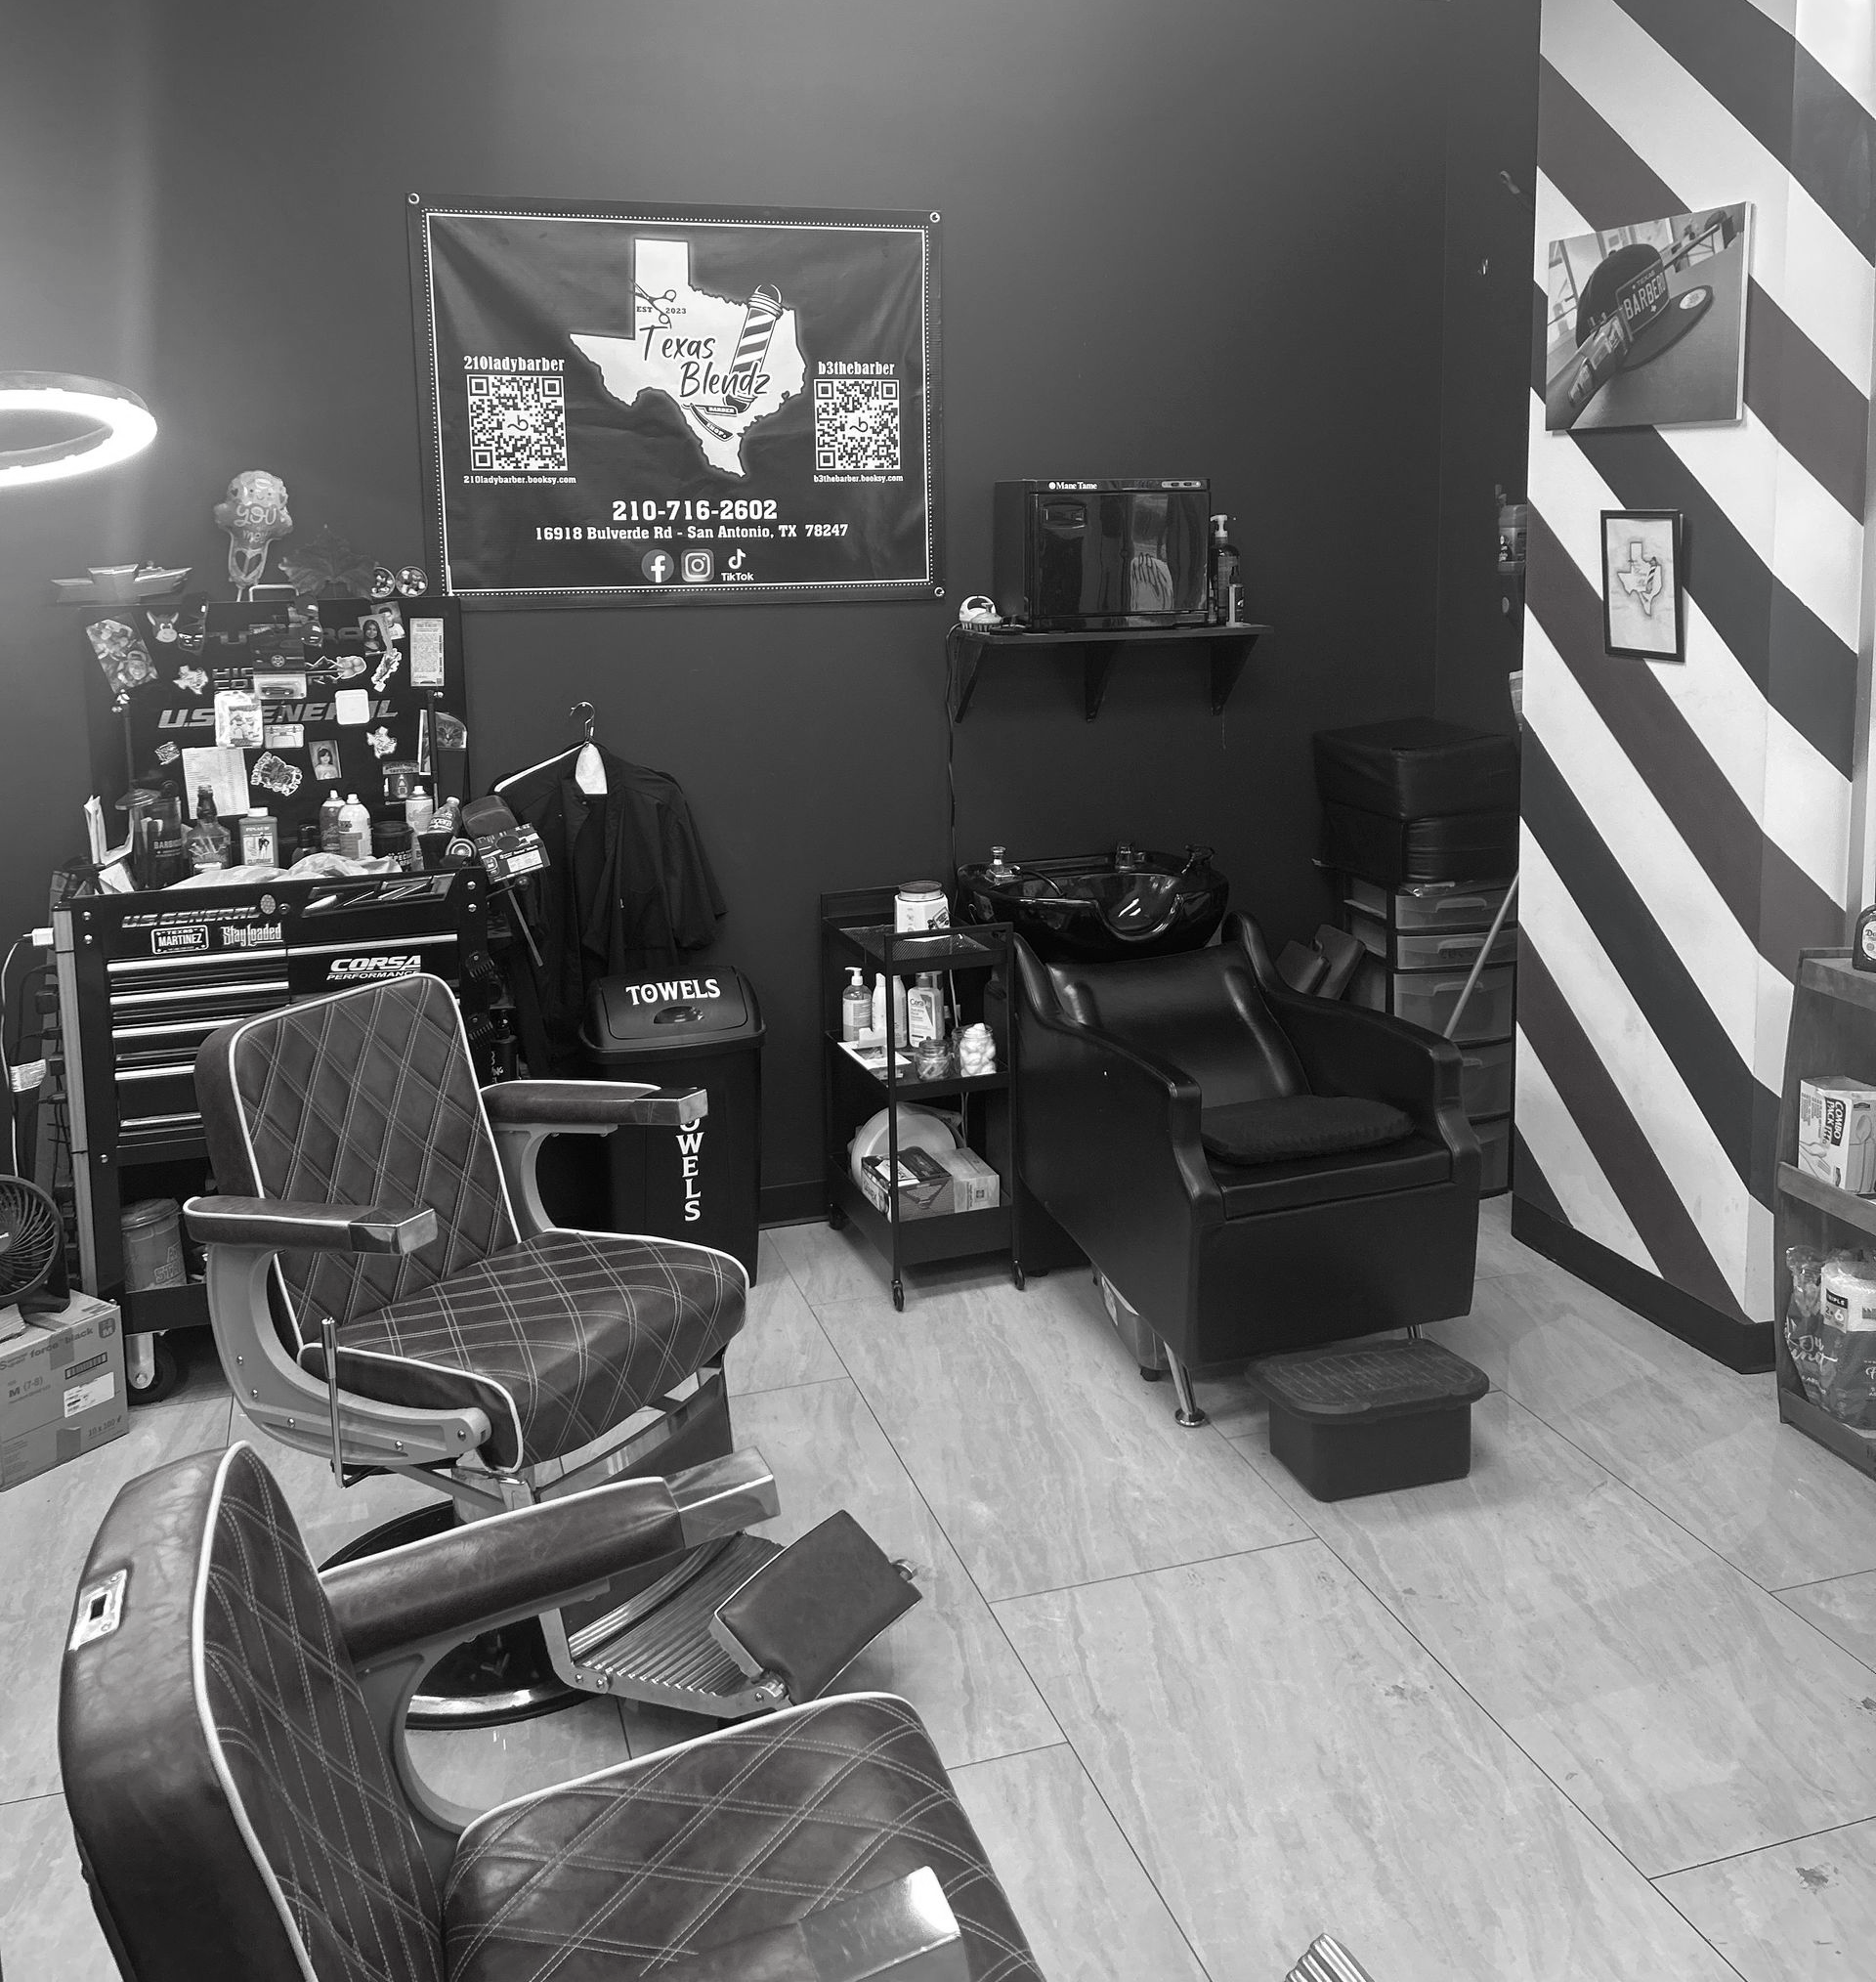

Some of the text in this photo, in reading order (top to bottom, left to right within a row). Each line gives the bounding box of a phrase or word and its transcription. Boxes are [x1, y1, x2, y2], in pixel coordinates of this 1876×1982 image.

[639, 324, 716, 361] Texas
[463, 356, 565, 372] 210ladybarber
[818, 361, 895, 375] b3thebarber
[680, 361, 771, 398] Blendz
[463, 475, 576, 486] 210ladybarber.booksy.com
[813, 474, 904, 484] b3thebarber.booksy.com
[612, 499, 778, 521] 210-716-2602
[535, 527, 583, 540] 16918
[586, 526, 650, 539] Bulverde
[654, 526, 673, 539] Rd
[687, 525, 714, 539] San
[717, 525, 775, 539] Antonio,
[778, 524, 797, 538] TX
[805, 523, 849, 537] 78247
[721, 572, 754, 582] TikTok
[159, 906, 263, 926] GENERAL
[157, 933, 203, 947] MARTINEZ
[330, 955, 422, 972] CORSA
[625, 978, 721, 1006] TOWELS
[1826, 1099, 1835, 1127] PACK
[1833, 1100, 1844, 1140] COMBO
[675, 1117, 704, 1222] OWELS
